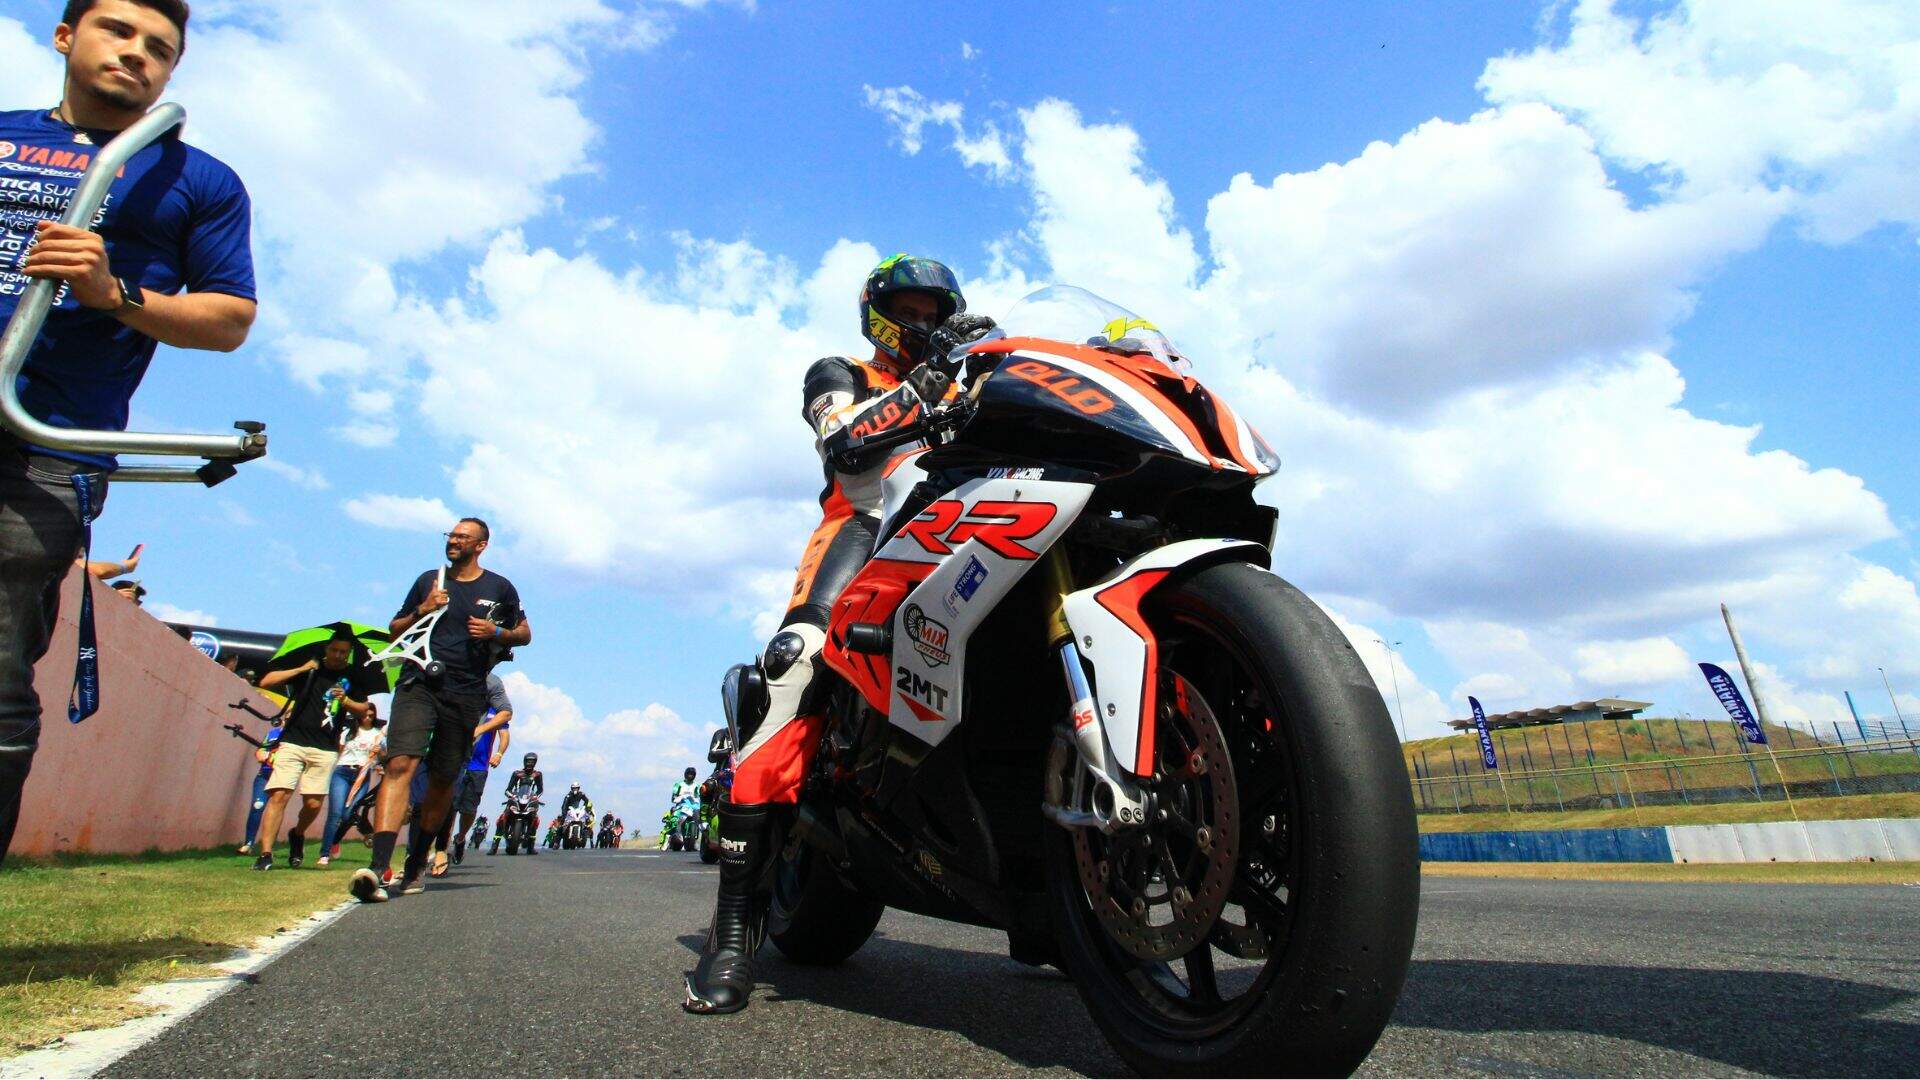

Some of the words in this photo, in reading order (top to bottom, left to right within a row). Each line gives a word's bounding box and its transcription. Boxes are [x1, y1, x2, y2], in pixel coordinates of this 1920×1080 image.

[896, 499, 1058, 561] RR
[920, 624, 947, 646] MIX
[896, 666, 949, 712] 2MT
[1710, 674, 1748, 728] YAMAHA
[1473, 707, 1492, 752] YAMAHA
